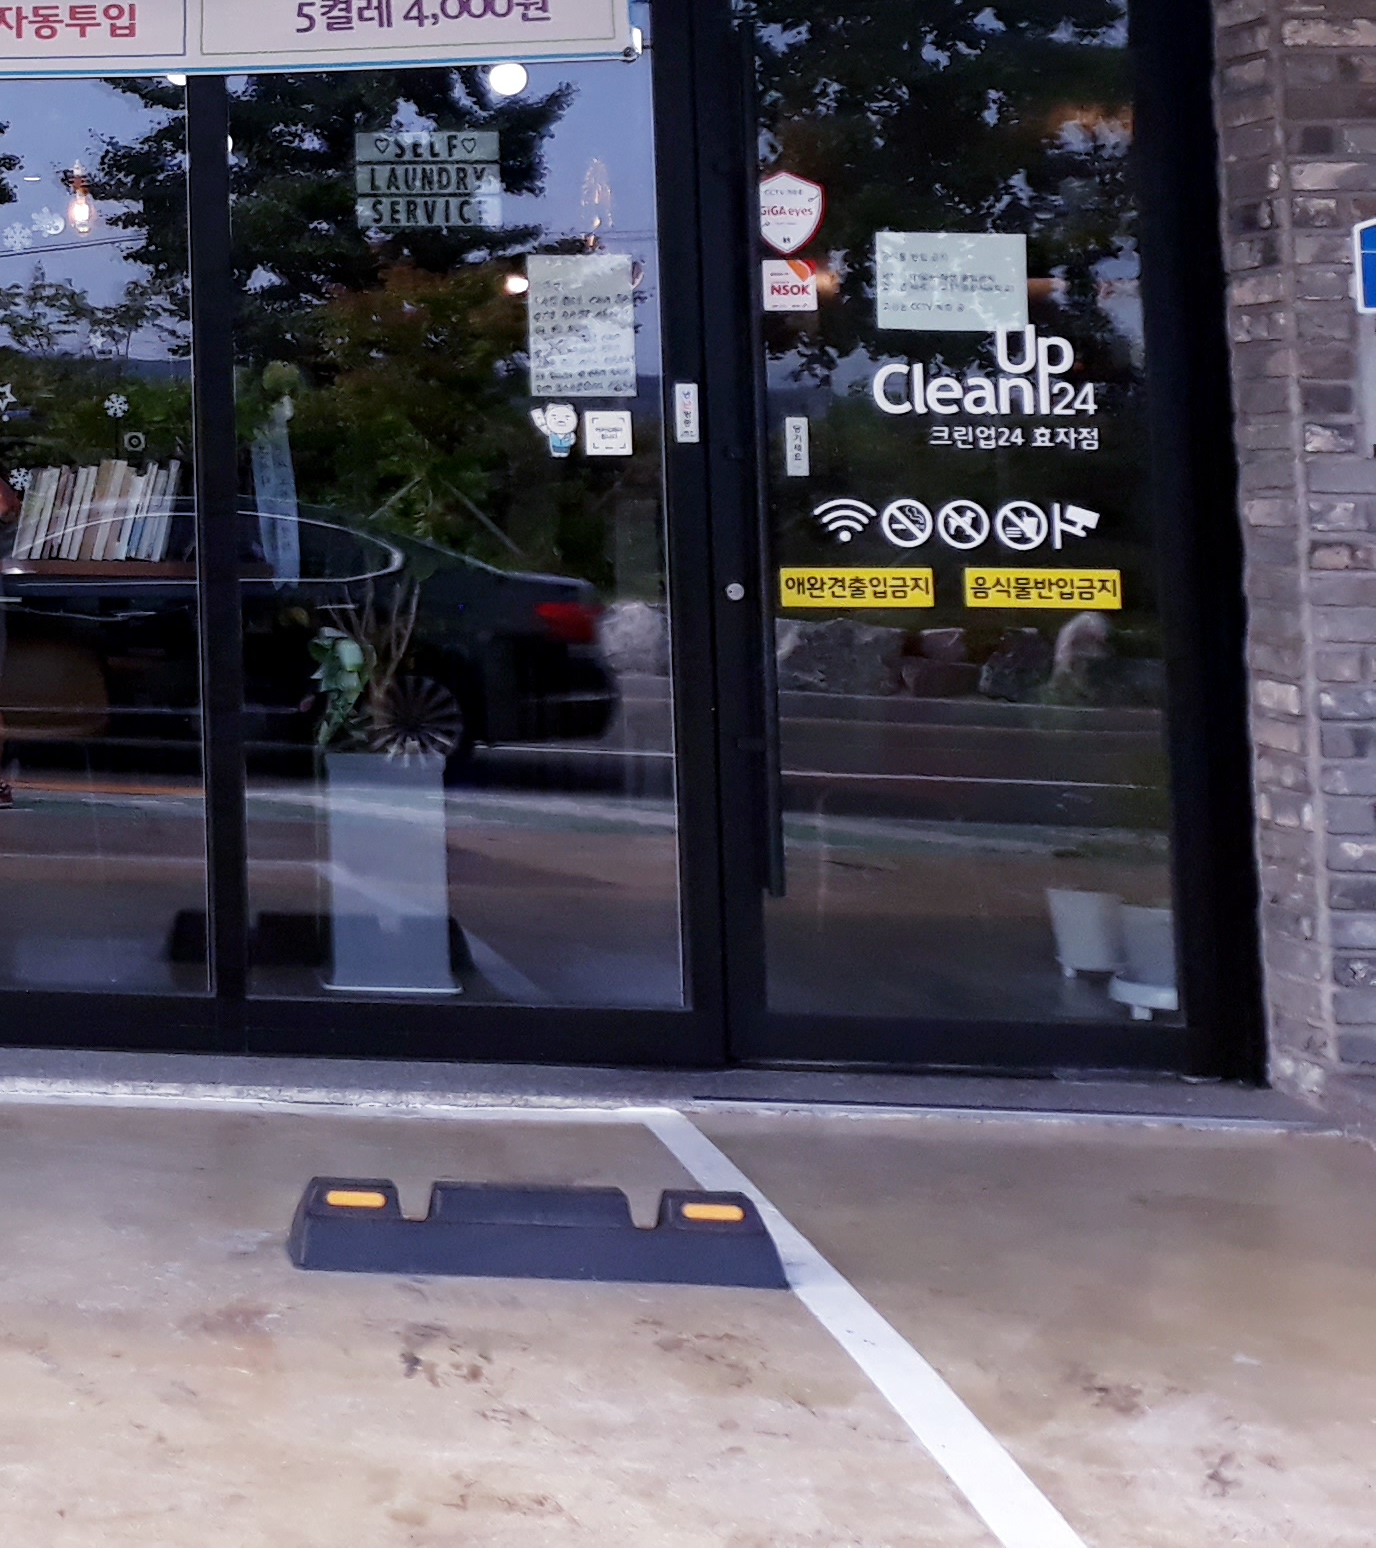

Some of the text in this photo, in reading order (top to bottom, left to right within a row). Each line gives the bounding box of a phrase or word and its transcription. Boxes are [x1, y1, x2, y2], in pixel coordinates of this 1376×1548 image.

[393, 134, 459, 159] SELF
[370, 166, 486, 192] LAUNDRY
[770, 283, 811, 296] NSOK
[872, 323, 1098, 415] Clean Up 24
[928, 425, 1099, 450] 크린업24 효자점
[785, 574, 931, 600] 애완견출입금지
[970, 575, 1118, 601] 음식물반입금지
